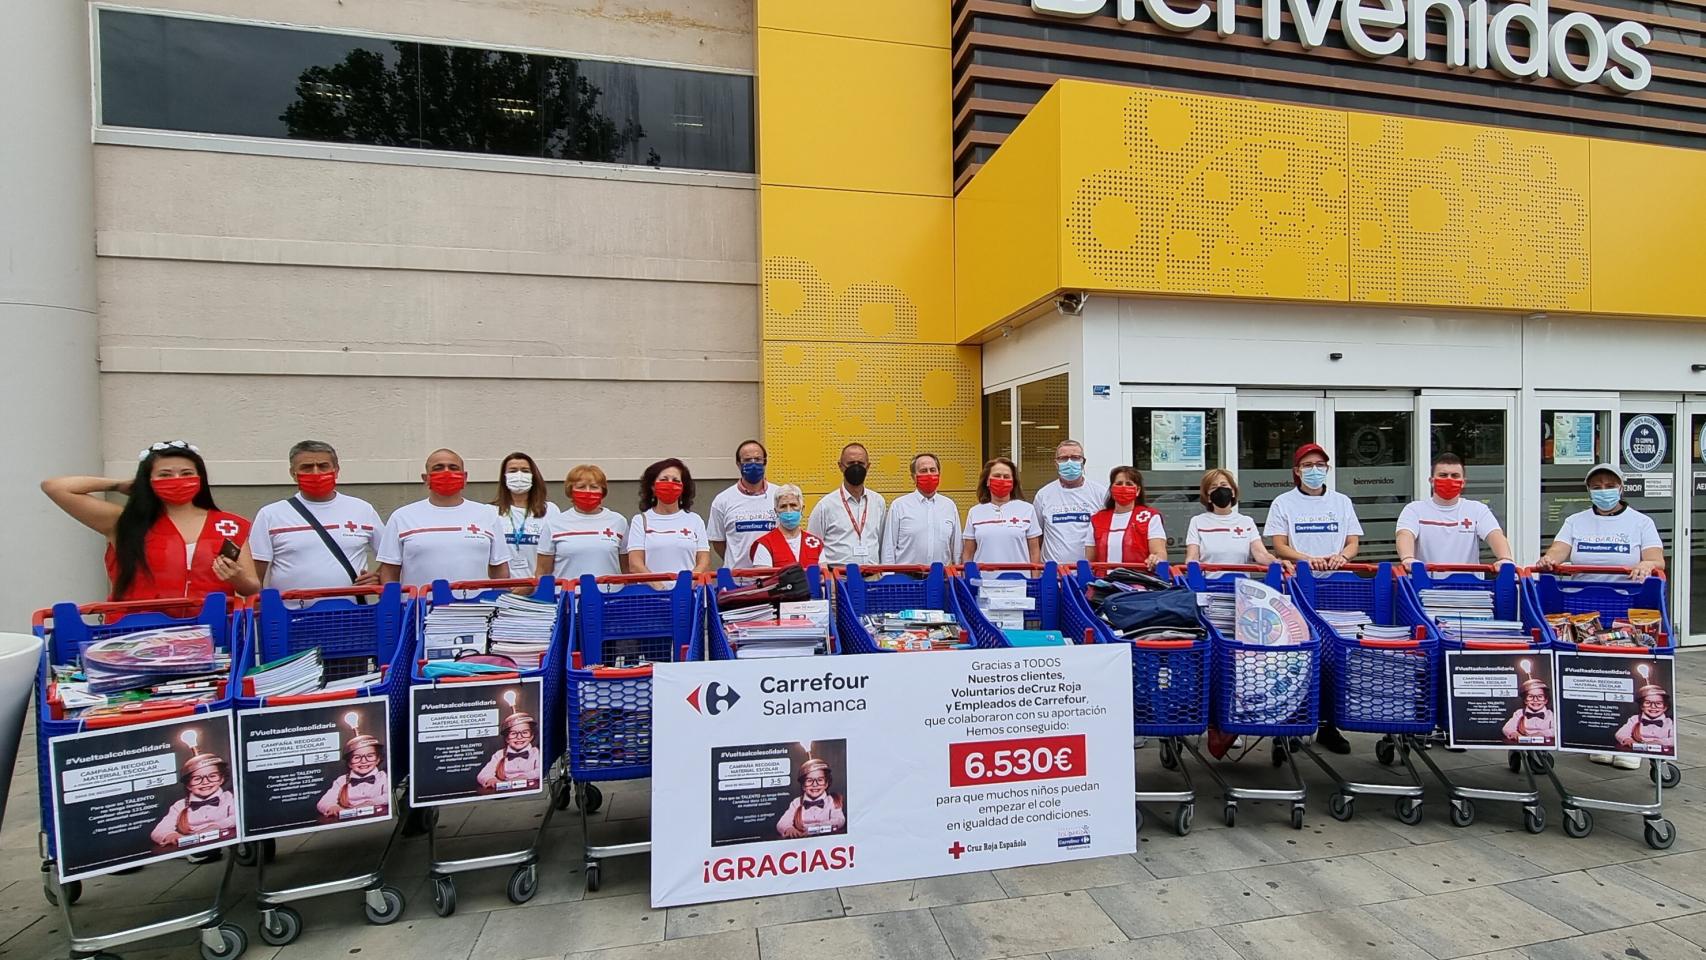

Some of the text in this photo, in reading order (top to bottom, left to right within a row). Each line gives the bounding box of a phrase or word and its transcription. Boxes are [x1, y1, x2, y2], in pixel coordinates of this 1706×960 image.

[1633, 444, 1656, 454] SEGURA
[1353, 477, 1395, 486] bienvenidos
[1623, 484, 1643, 492] ENOR
[971, 657, 1061, 671] Gracias a TODOS
[760, 672, 869, 694] Carrefour
[968, 670, 1066, 684] Nuestros clientes,
[951, 684, 1016, 698] Voluntarios
[1058, 681, 1082, 693] Roja
[763, 698, 867, 716] Salamanca
[945, 695, 1089, 713] y Empleados de Carrefour,
[924, 705, 1107, 728] que colaboraron con su aportación
[966, 721, 1070, 737] Hemos conseguido:
[65, 742, 171, 765] #Vueltaalcolesolidaria
[964, 747, 1073, 779] 6.530€
[936, 781, 1100, 807] para que muchos niños puedan
[978, 798, 1062, 816] empezar el cole
[946, 808, 1091, 832] en igualdad de condiciones.
[967, 839, 1027, 853] Cruz Roja Española
[703, 845, 855, 883] ¡GRACIAS!
